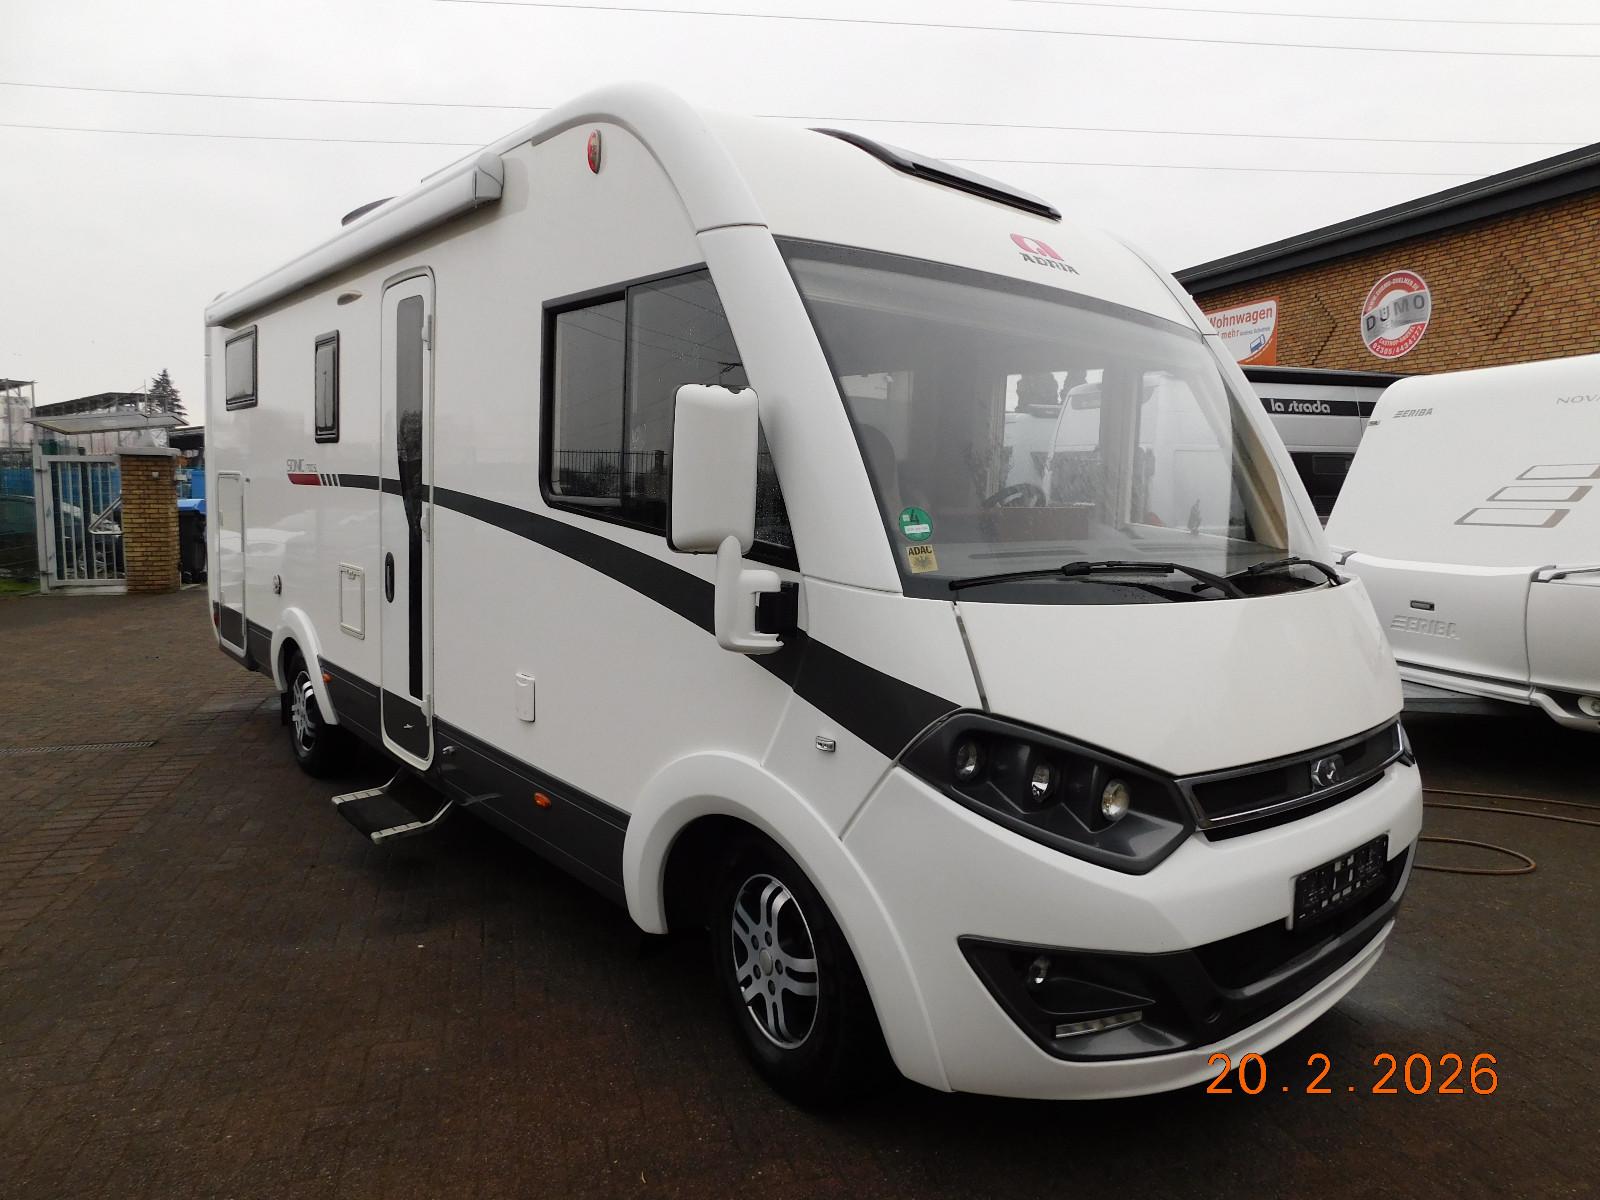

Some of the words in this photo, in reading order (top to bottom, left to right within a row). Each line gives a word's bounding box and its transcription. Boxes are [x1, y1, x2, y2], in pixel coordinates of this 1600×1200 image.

[1556, 394, 1600, 405] NOV
[1270, 398, 1285, 412] la
[1288, 400, 1331, 413] strada
[1393, 408, 1433, 419] ERIBA
[909, 508, 920, 525] 4
[908, 545, 932, 556] ADAC
